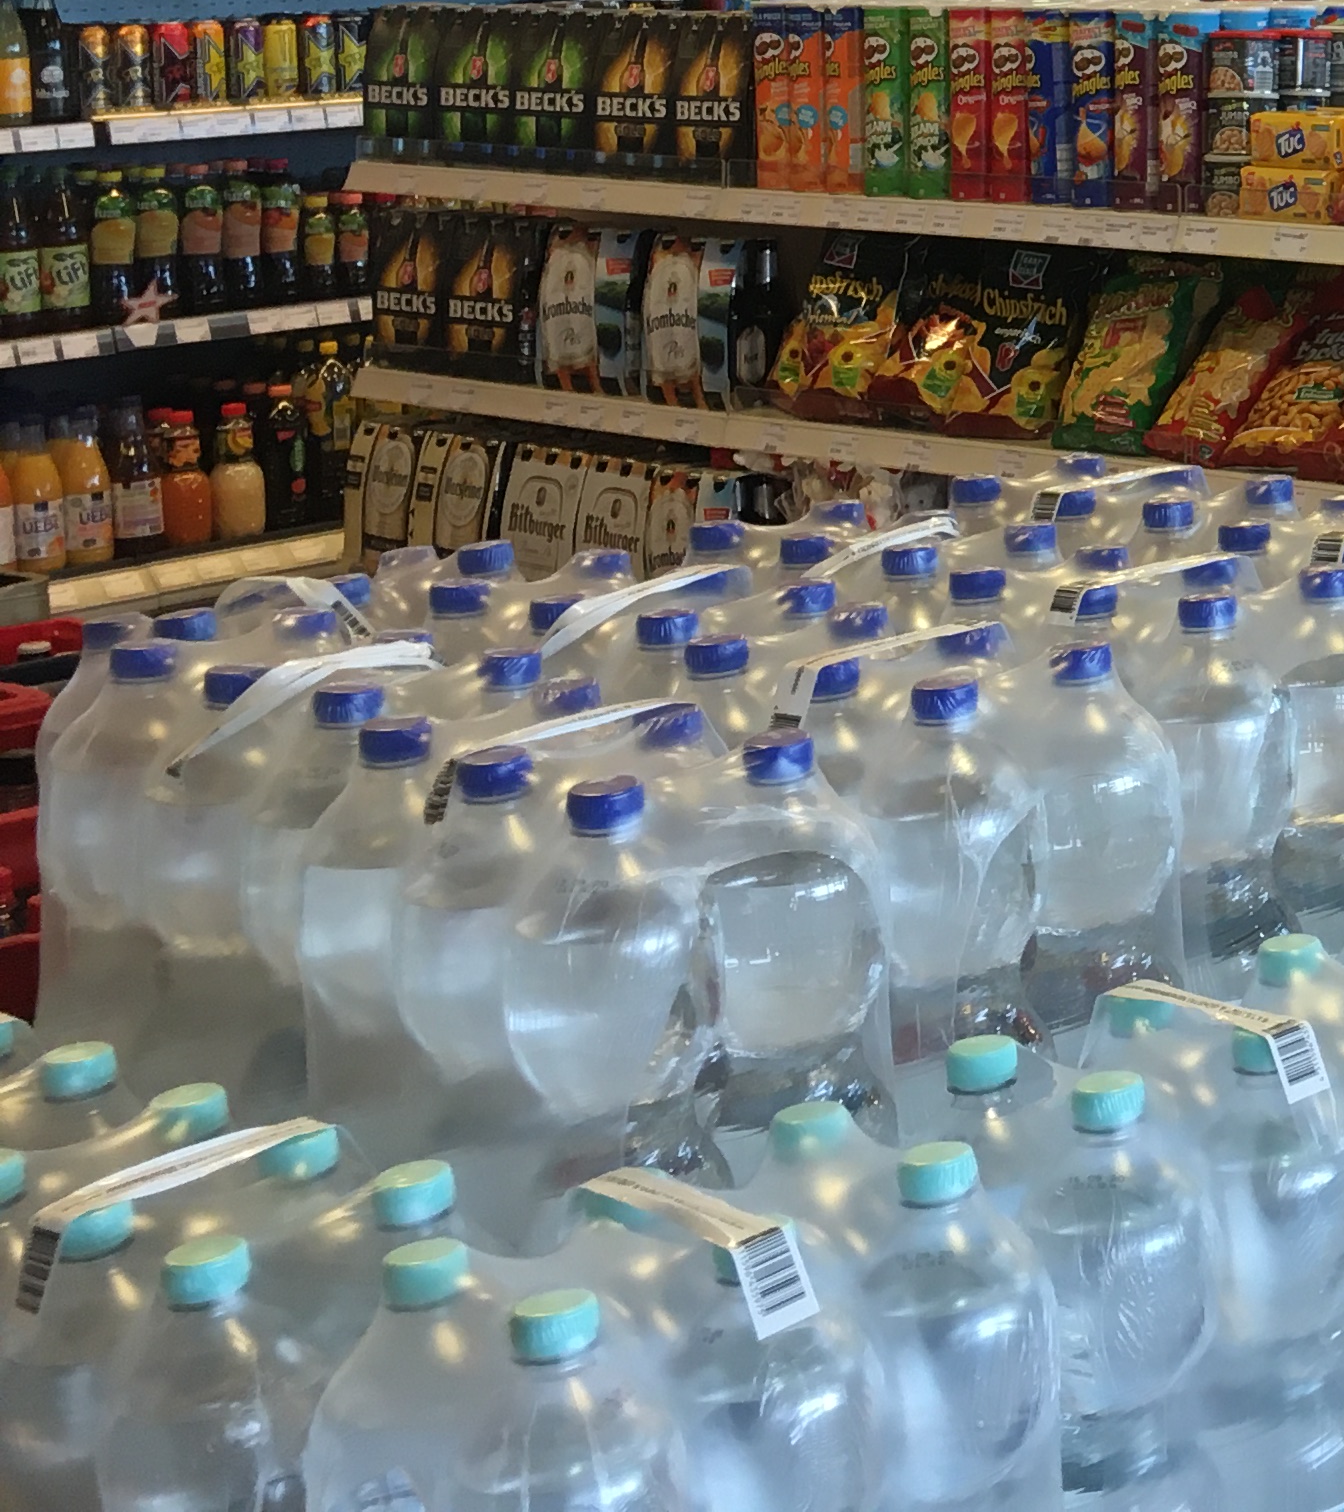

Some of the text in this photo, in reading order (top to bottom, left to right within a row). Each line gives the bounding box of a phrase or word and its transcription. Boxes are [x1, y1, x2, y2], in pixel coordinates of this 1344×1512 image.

[368, 85, 428, 106] BECK'S
[440, 86, 510, 110] BECK'S
[515, 90, 584, 113] BECK'S
[596, 96, 667, 119] BECK'S
[676, 99, 741, 121] BECK'S
[1277, 133, 1304, 155] TUC
[1269, 185, 1296, 207] TUC
[377, 290, 436, 316] BECK'S
[448, 298, 514, 324] BECK'S
